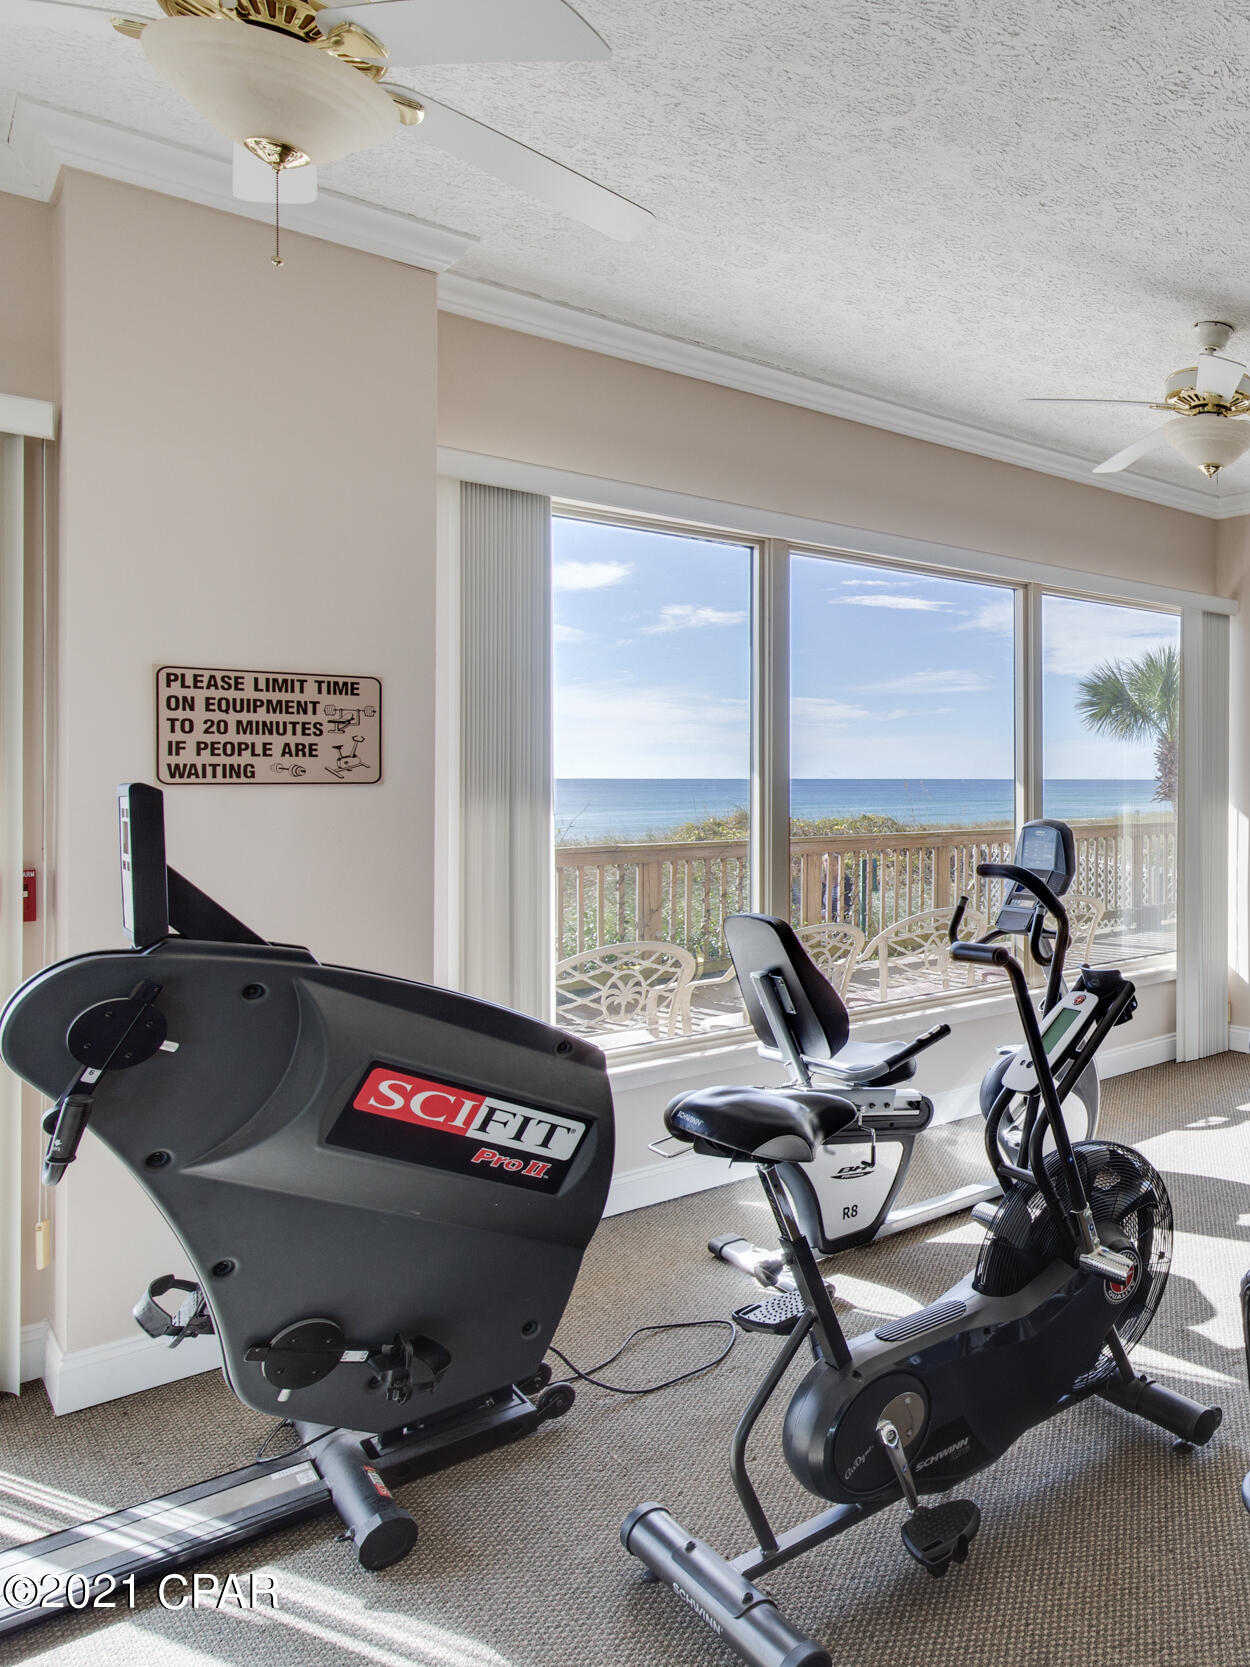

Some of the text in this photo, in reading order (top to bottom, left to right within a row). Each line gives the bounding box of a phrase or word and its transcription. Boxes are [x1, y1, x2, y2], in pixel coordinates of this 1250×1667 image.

[165, 672, 361, 697] PLEASE LIMIT TIME
[165, 694, 321, 716] ON EQUIPMENT
[166, 717, 324, 737] TO 20 MINUTES
[167, 740, 319, 758] IF PEOPLE ARE
[166, 762, 256, 779] WAITING
[367, 1079, 572, 1151] SCIFIT
[471, 1147, 551, 1179] Pro II
[842, 1204, 859, 1220] R8
[915, 1437, 969, 1472] SCHWINN
[672, 1582, 722, 1635] SCHWINN
